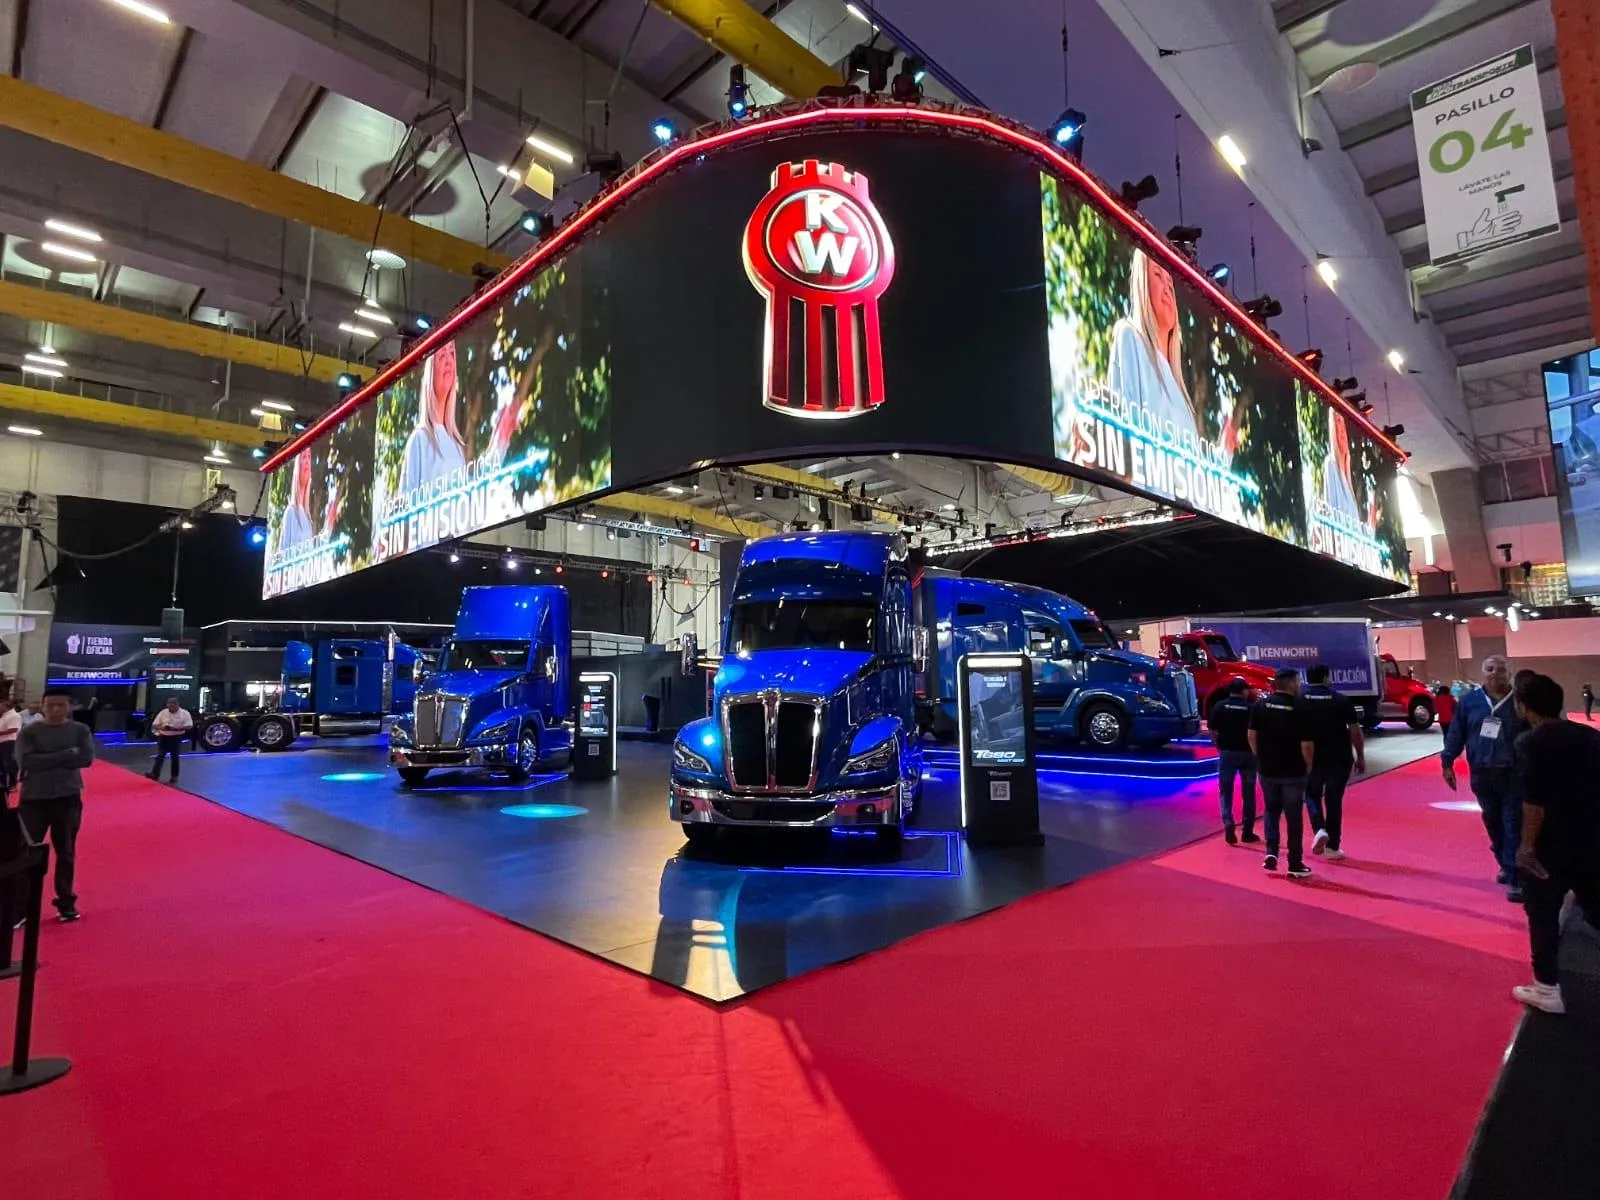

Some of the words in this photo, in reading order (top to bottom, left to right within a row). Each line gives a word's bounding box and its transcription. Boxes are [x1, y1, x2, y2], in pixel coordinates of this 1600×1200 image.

[1435, 87, 1515, 126] PASILLO
[1429, 108, 1533, 174] 04
[1468, 181, 1502, 195] MANOS
[1077, 413, 1125, 475] SIN
[435, 449, 502, 498] SILENCIOSA
[379, 520, 405, 560] SIN
[85, 646, 114, 656] OFICIAL
[87, 636, 113, 646] TIENDA
[1260, 646, 1318, 658] KENWORTH
[67, 671, 122, 680] KENWORTH
